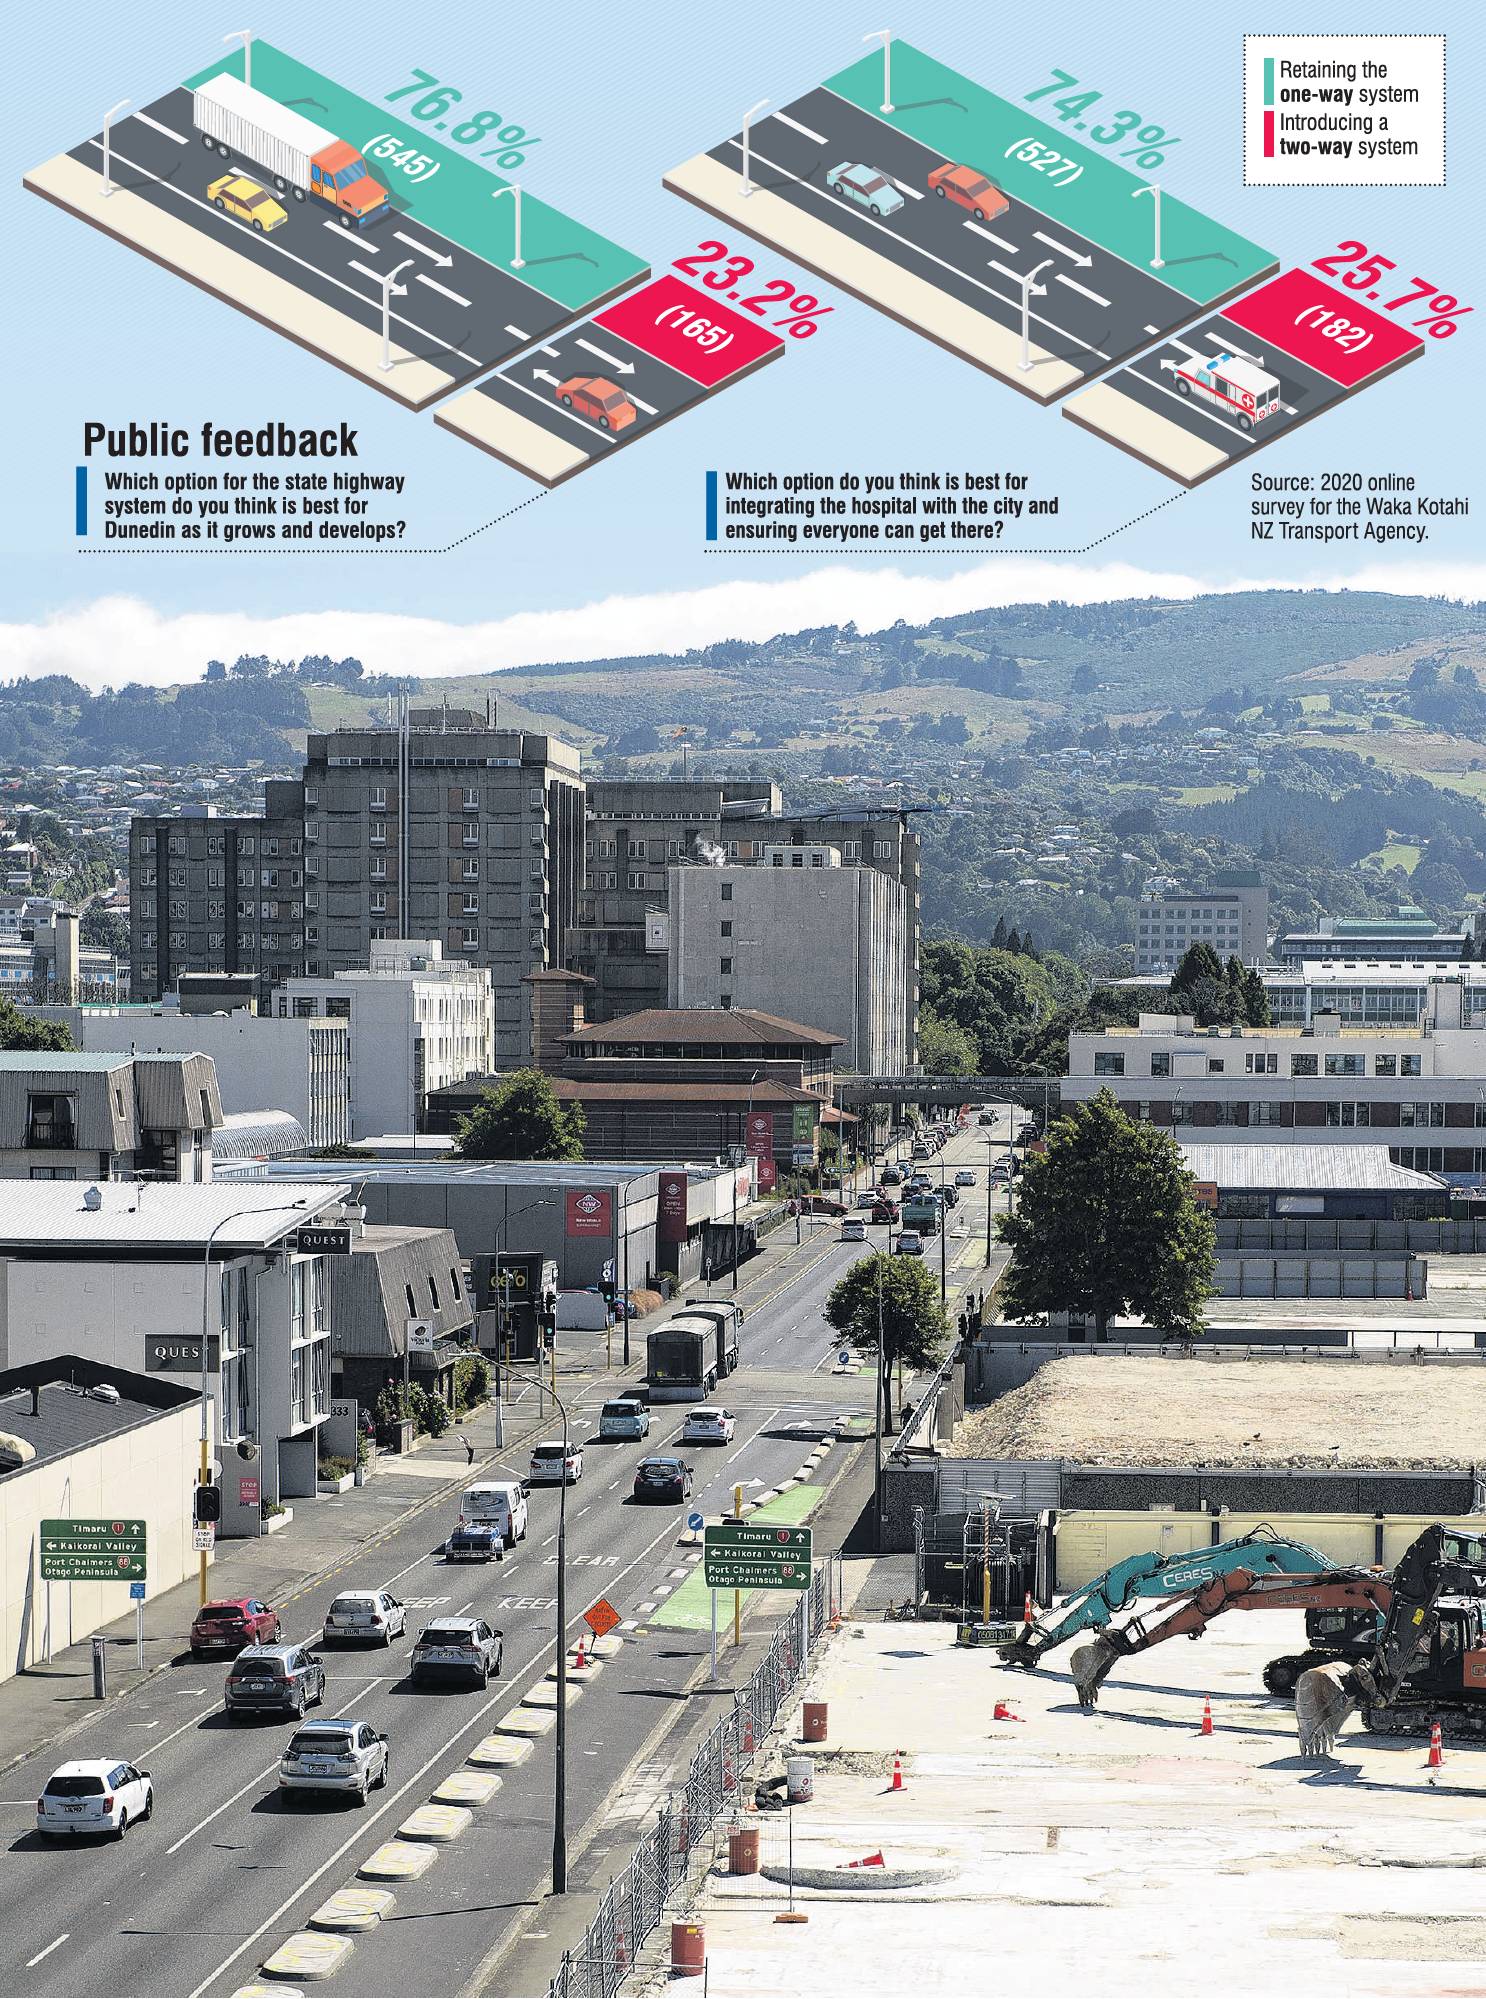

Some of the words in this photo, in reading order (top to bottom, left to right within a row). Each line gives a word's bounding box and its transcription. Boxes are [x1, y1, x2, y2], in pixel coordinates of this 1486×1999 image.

[303, 1235, 345, 1247] QUEST
[154, 1346, 209, 1360] QUES
[73, 1525, 107, 1533] Timaru
[737, 1532, 772, 1540] Timaru
[60, 1542, 102, 1550] Kaikorai
[106, 1542, 137, 1552] Valley
[725, 1549, 767, 1558] Kaikorai
[771, 1550, 802, 1561] Valley
[45, 1558, 65, 1566] Port
[69, 1558, 113, 1566] Chalmers
[45, 1568, 71, 1577] Otago
[74, 1568, 119, 1576] Peninsula
[708, 1565, 730, 1574] Port
[733, 1565, 778, 1574] Chalmers
[783, 1566, 793, 1574] 88
[708, 1576, 735, 1585] Otago
[738, 1575, 783, 1585] Peninsula
[1163, 1567, 1213, 1587] CERES
[397, 1596, 452, 1608] EEP
